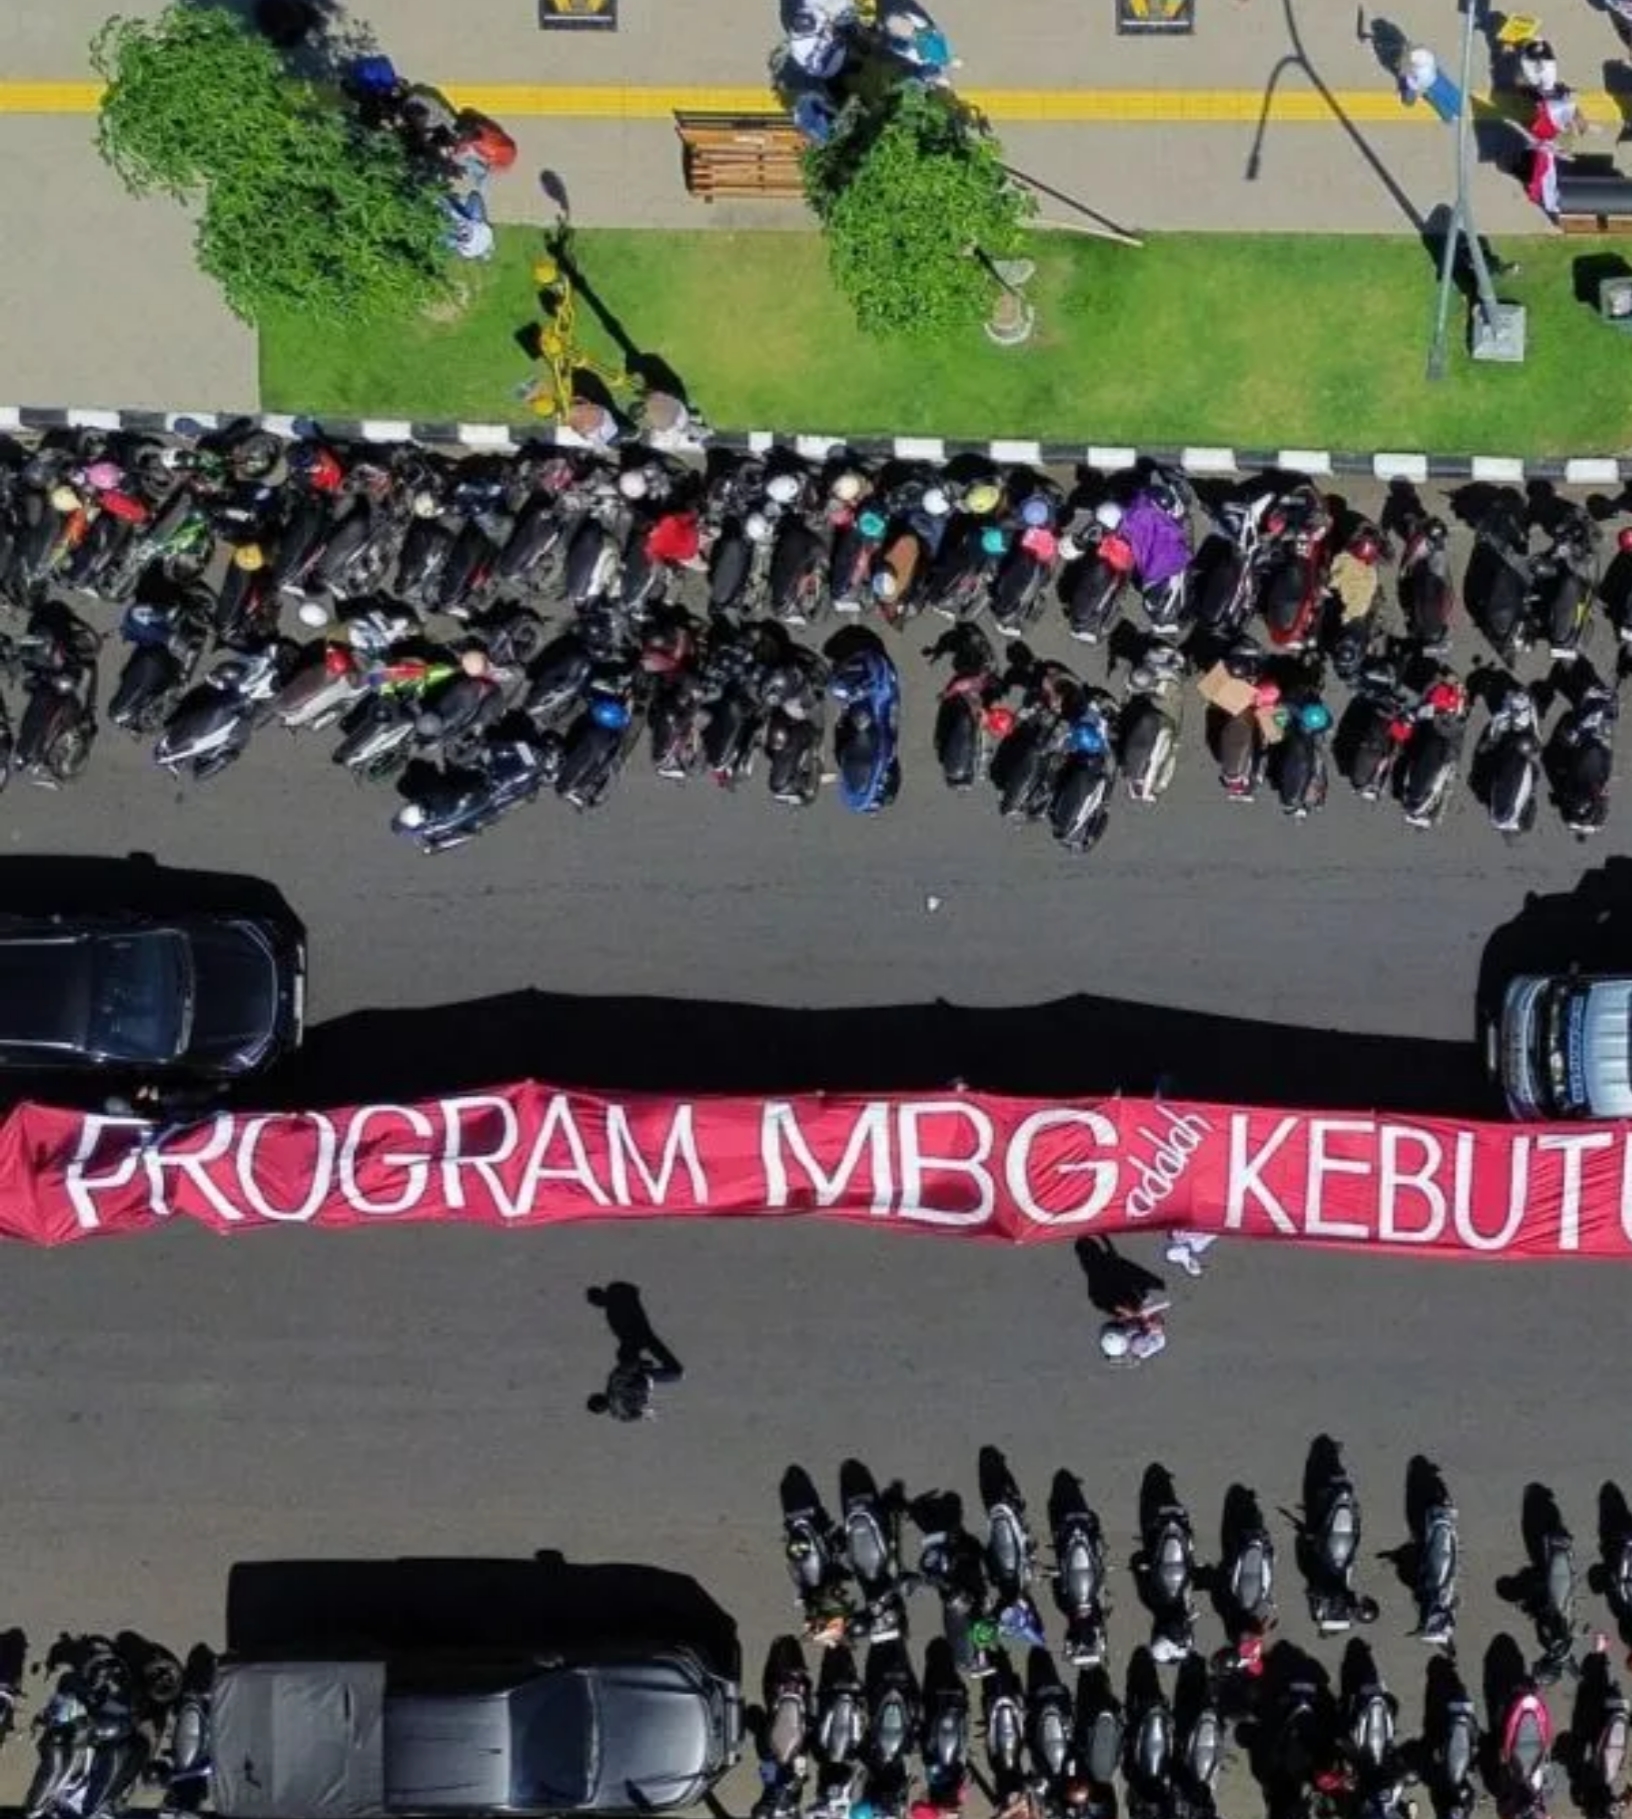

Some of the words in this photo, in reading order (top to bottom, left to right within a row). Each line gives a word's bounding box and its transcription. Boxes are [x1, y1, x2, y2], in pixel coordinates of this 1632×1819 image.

[65, 1093, 711, 1229] PROGRAM
[760, 1100, 1119, 1226] MBG
[1125, 1104, 1213, 1217] adalah
